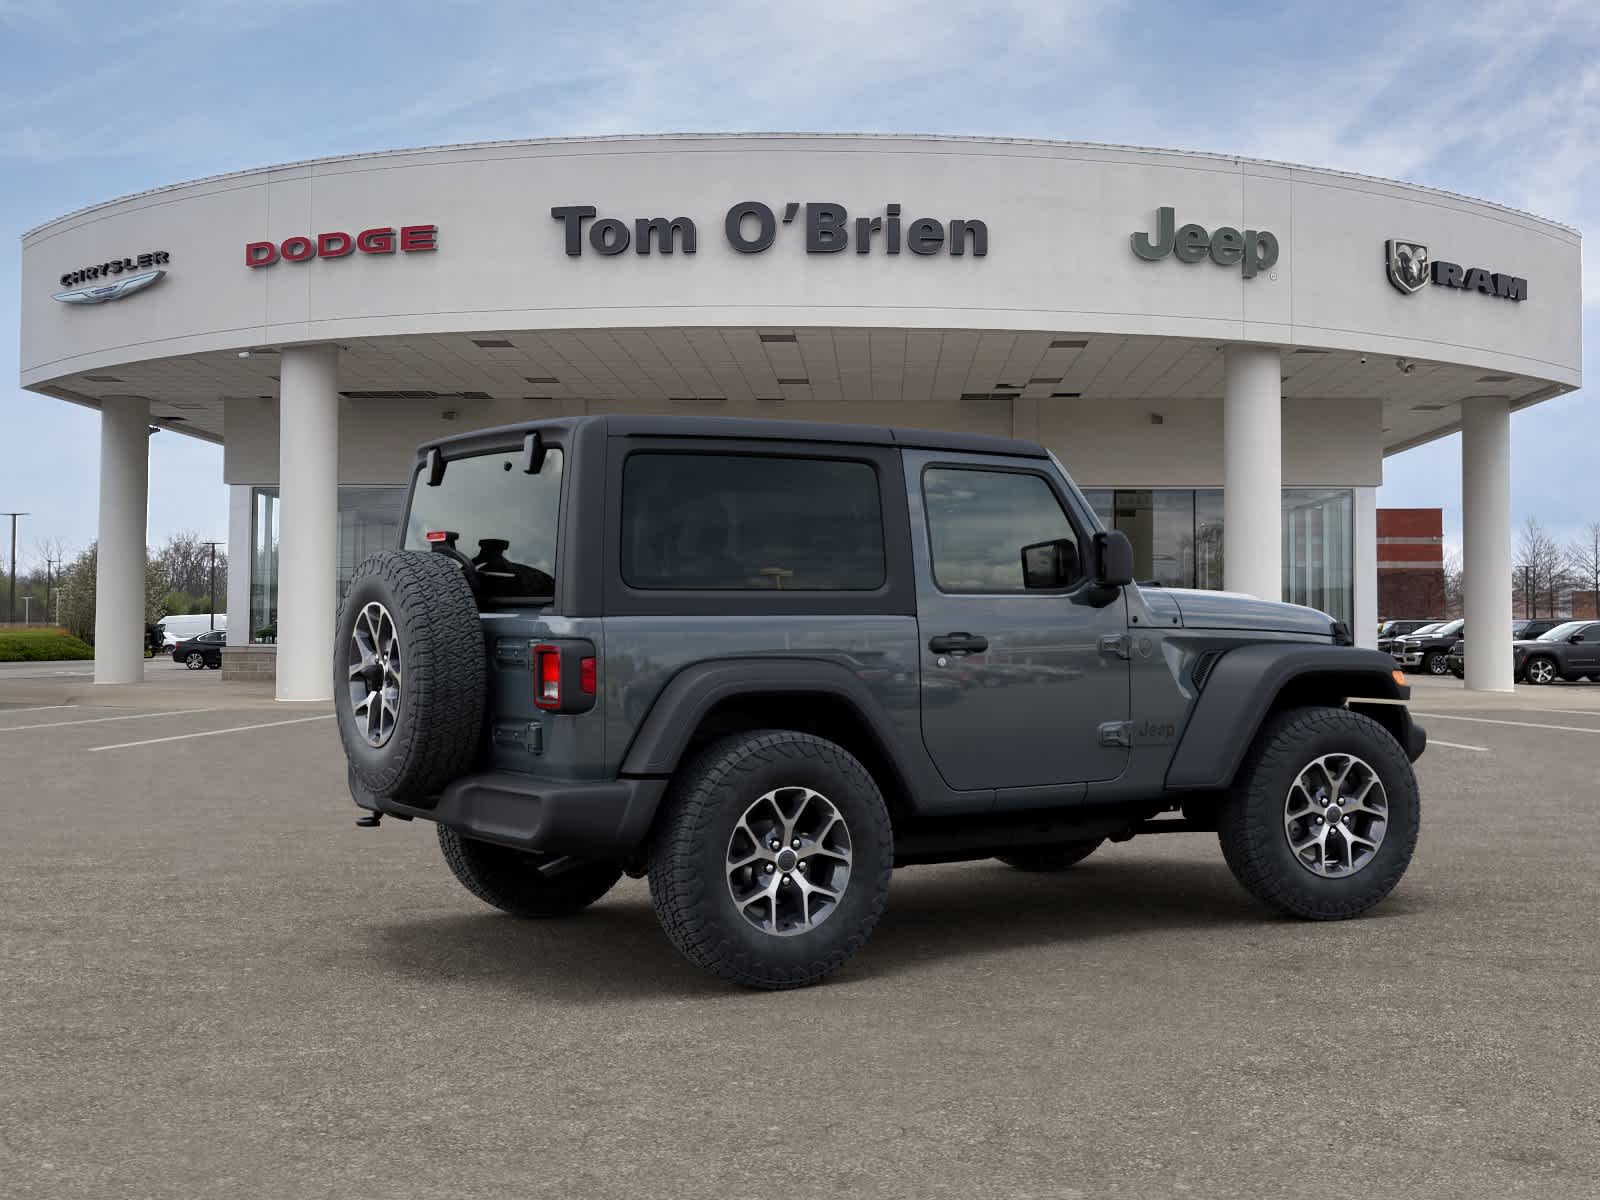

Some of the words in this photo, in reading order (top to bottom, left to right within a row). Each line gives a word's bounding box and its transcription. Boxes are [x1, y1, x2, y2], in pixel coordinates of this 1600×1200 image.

[246, 225, 438, 268] DODGE
[551, 206, 697, 257] Tom
[1130, 207, 1279, 278] Jeep
[60, 251, 169, 287] CHRYSLER
[1430, 261, 1527, 302] RAM
[1139, 720, 1175, 738] Jeep
